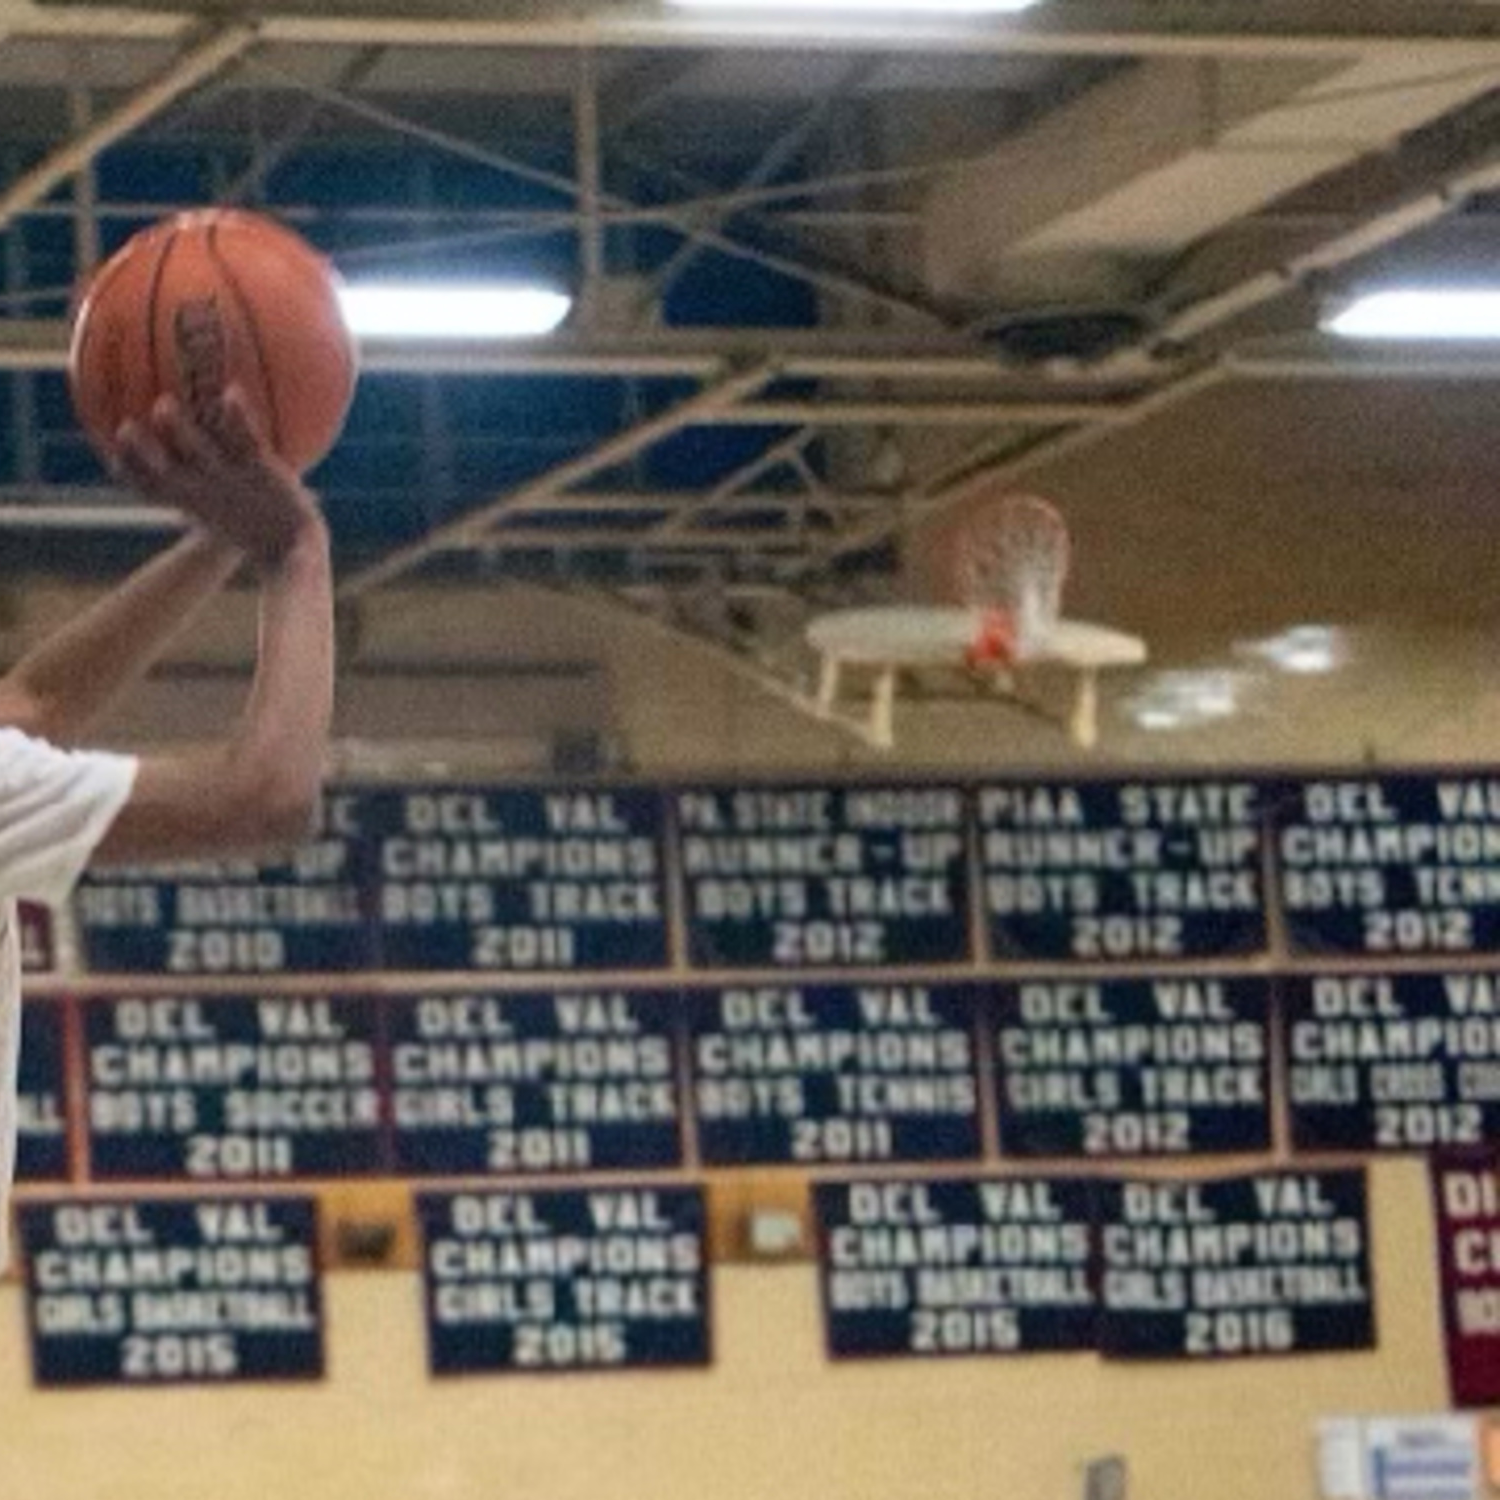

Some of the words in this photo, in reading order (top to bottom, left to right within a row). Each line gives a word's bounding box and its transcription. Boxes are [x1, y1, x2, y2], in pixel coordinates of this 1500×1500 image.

[406, 794, 500, 831] DEL
[545, 793, 629, 831] VAL
[980, 790, 1084, 823] PIAA
[1119, 786, 1256, 823] STATE
[1306, 783, 1396, 821] DEL
[381, 836, 656, 876] CHAMPIONS
[382, 884, 494, 921] BOYS
[530, 882, 660, 920] TRACK
[697, 879, 807, 919] BOYS
[824, 876, 953, 915] TRACK
[984, 875, 1097, 912] BOYS
[1133, 873, 1256, 909] TRACK
[1283, 870, 1385, 908] BOYS
[472, 926, 575, 966] 2011
[772, 921, 884, 961] 2012
[1073, 915, 1184, 956] 2012
[1364, 910, 1473, 949] 2012
[417, 998, 512, 1036] DEL
[554, 996, 639, 1035] VAL
[721, 990, 816, 1027] DEL
[857, 988, 941, 1026] VAL
[1019, 984, 1114, 1022] DEL
[1150, 981, 1234, 1020] VAL
[1312, 977, 1403, 1017] DEL
[1443, 974, 1500, 1015] VA
[114, 998, 216, 1039] DEL
[257, 998, 346, 1038] VAL
[397, 1039, 670, 1080] CHAMPIONS
[700, 1031, 970, 1072] CHAMPIONS
[1001, 1022, 1264, 1063] CHAMPIONS
[1291, 1019, 1500, 1060] CHAMPIO
[90, 1043, 375, 1082] CHAMPIONS
[396, 1086, 513, 1126] GIRLS
[548, 1083, 677, 1122] TRACK
[698, 1079, 805, 1118] BOYS
[835, 1076, 976, 1115] TENNIS
[1006, 1072, 1120, 1112] GIRLS
[1139, 1067, 1263, 1104] TRACK
[90, 1091, 197, 1131] BOYS
[225, 1090, 379, 1129] SOCCER
[1374, 1104, 1482, 1144] 2012
[488, 1128, 590, 1167] 2011
[792, 1121, 892, 1160] 2011
[1081, 1113, 1192, 1152] 2012
[186, 1136, 294, 1175] 2011
[453, 1195, 550, 1234] DEL
[589, 1193, 672, 1231] VAL
[849, 1184, 941, 1222] DEL
[980, 1183, 1061, 1220] VAL
[1124, 1184, 1215, 1221] DEL
[1254, 1178, 1335, 1215] VAL
[56, 1207, 153, 1243] DEL
[195, 1205, 283, 1240] VAL
[1102, 1219, 1361, 1264] CHAMPIONS
[431, 1236, 699, 1278] CHAMPIONS
[831, 1224, 1090, 1266] CHAMPIONS
[35, 1247, 312, 1289] CHAMPIONS
[832, 1271, 910, 1310] BOYS
[917, 1267, 1093, 1306] BASKETBALL
[1103, 1271, 1186, 1310] GIRLS
[1192, 1264, 1366, 1304] BASKETBALL
[37, 1295, 124, 1335] GIRLS
[133, 1292, 318, 1332] BASKETBALL
[436, 1282, 556, 1323] GIRLS
[573, 1279, 697, 1317] TRACK
[513, 1324, 627, 1365] 2015
[911, 1312, 1021, 1351] 2015
[1185, 1310, 1295, 1353] 2016
[121, 1336, 238, 1376] 2015
